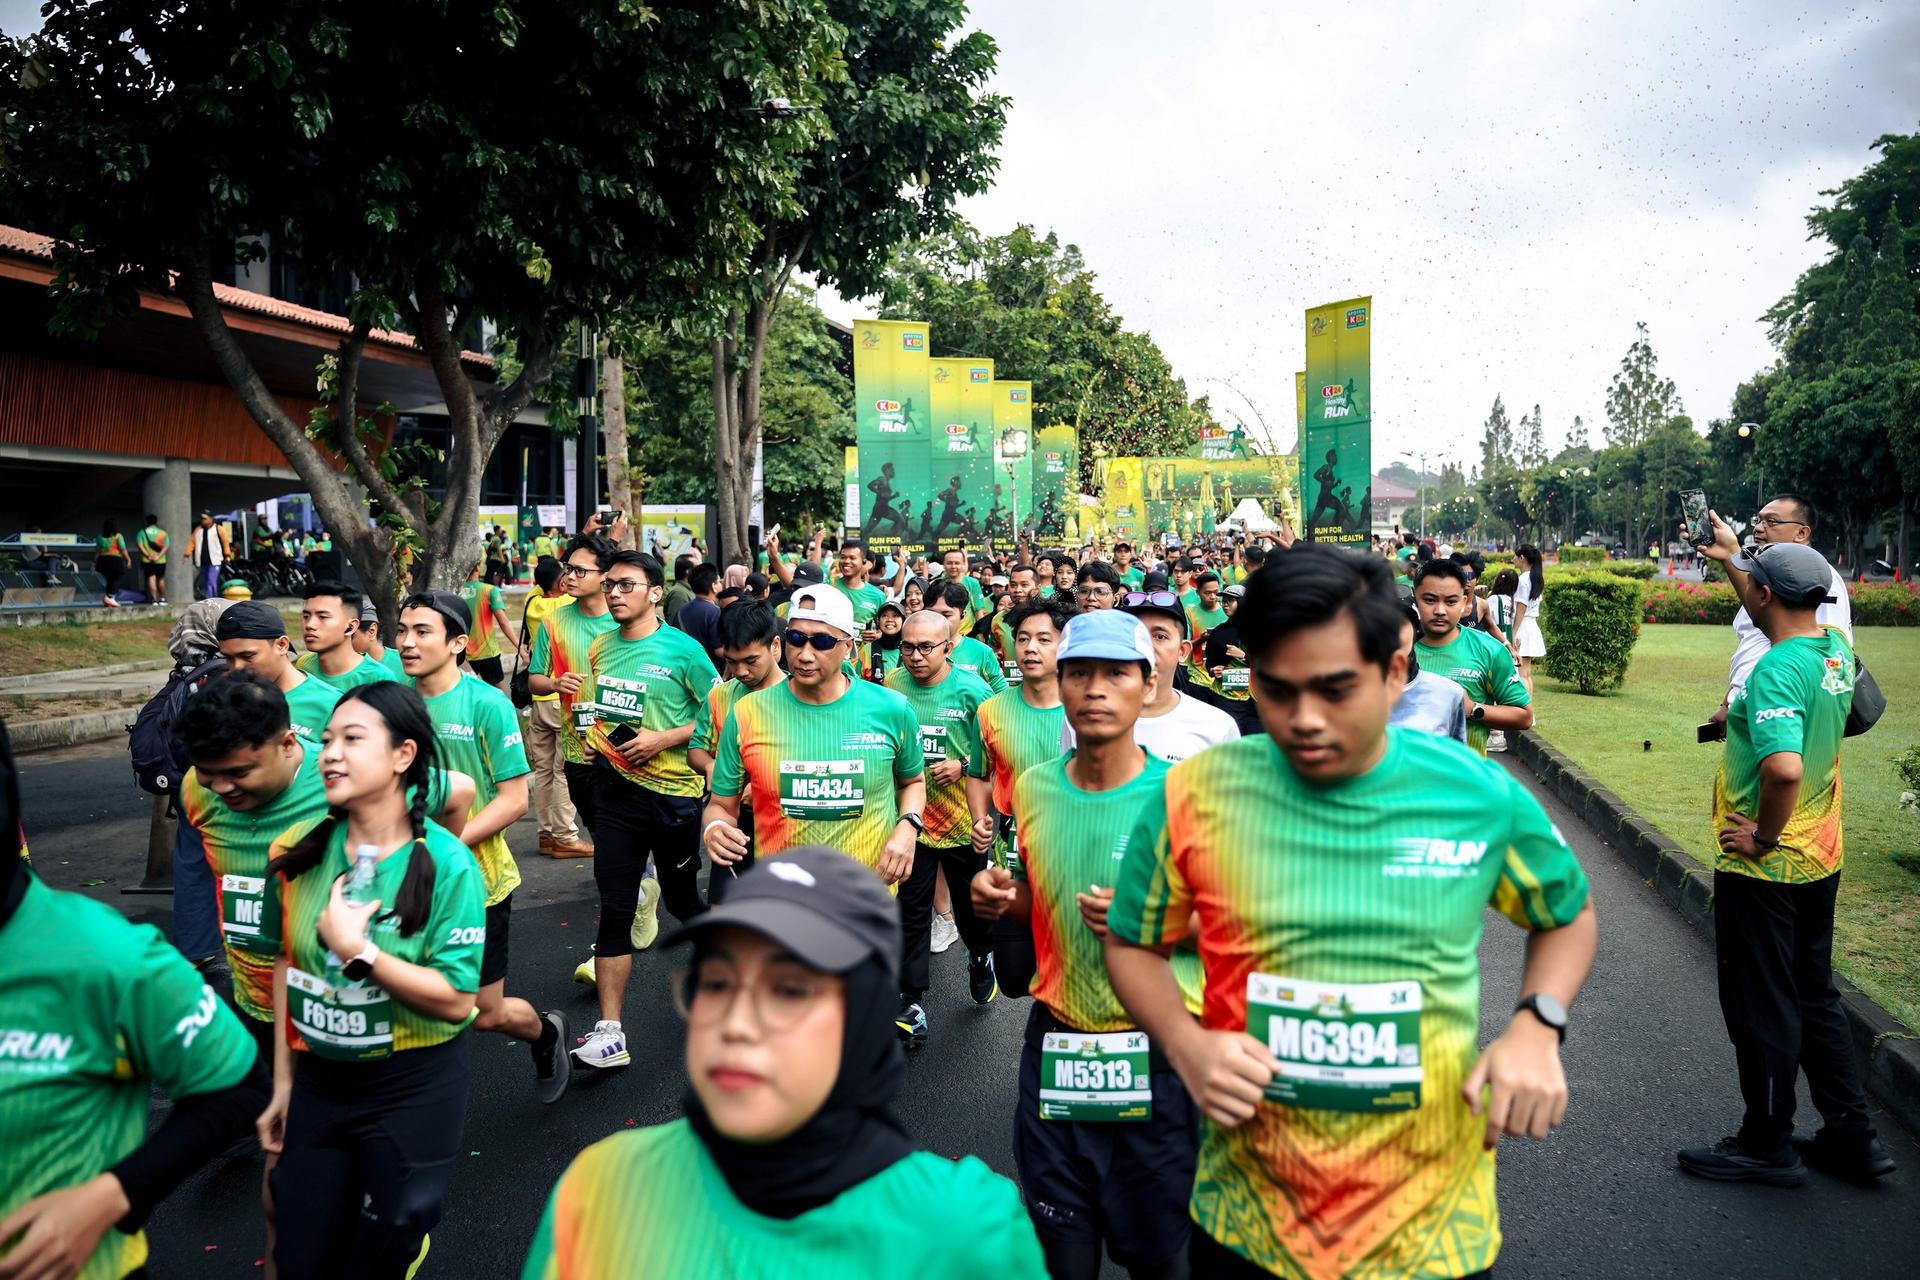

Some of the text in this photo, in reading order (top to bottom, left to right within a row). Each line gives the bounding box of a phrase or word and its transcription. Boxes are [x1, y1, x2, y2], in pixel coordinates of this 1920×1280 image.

[1324, 406, 1350, 419] RUN
[878, 421, 909, 432] RUN
[948, 442, 974, 451] RUN
[1202, 448, 1236, 459] RUN
[1314, 526, 1343, 535] RUN FOR
[868, 537, 885, 545] RUN
[1339, 534, 1364, 542] HEALTH
[869, 545, 891, 553] BETTE
[649, 664, 672, 676] RUN
[1009, 668, 1023, 678] M5
[1460, 668, 1481, 678] RUN
[602, 689, 637, 710] M5672
[578, 711, 595, 726] M5
[947, 709, 967, 719] RUN
[1755, 707, 1796, 724] 2026
[449, 723, 474, 736] RUN
[861, 733, 886, 744] RUN
[923, 738, 938, 752] 91
[849, 762, 860, 771] 5K
[792, 778, 853, 799] M5434
[1111, 851, 1124, 860] FO
[1426, 838, 1488, 865] RUN
[235, 898, 263, 925] M6
[303, 997, 367, 1036] F6139
[1, 1030, 73, 1060] RUN
[1127, 1035, 1142, 1048] 5K
[1268, 1014, 1399, 1065] M6394
[1054, 1058, 1132, 1090] M5313
